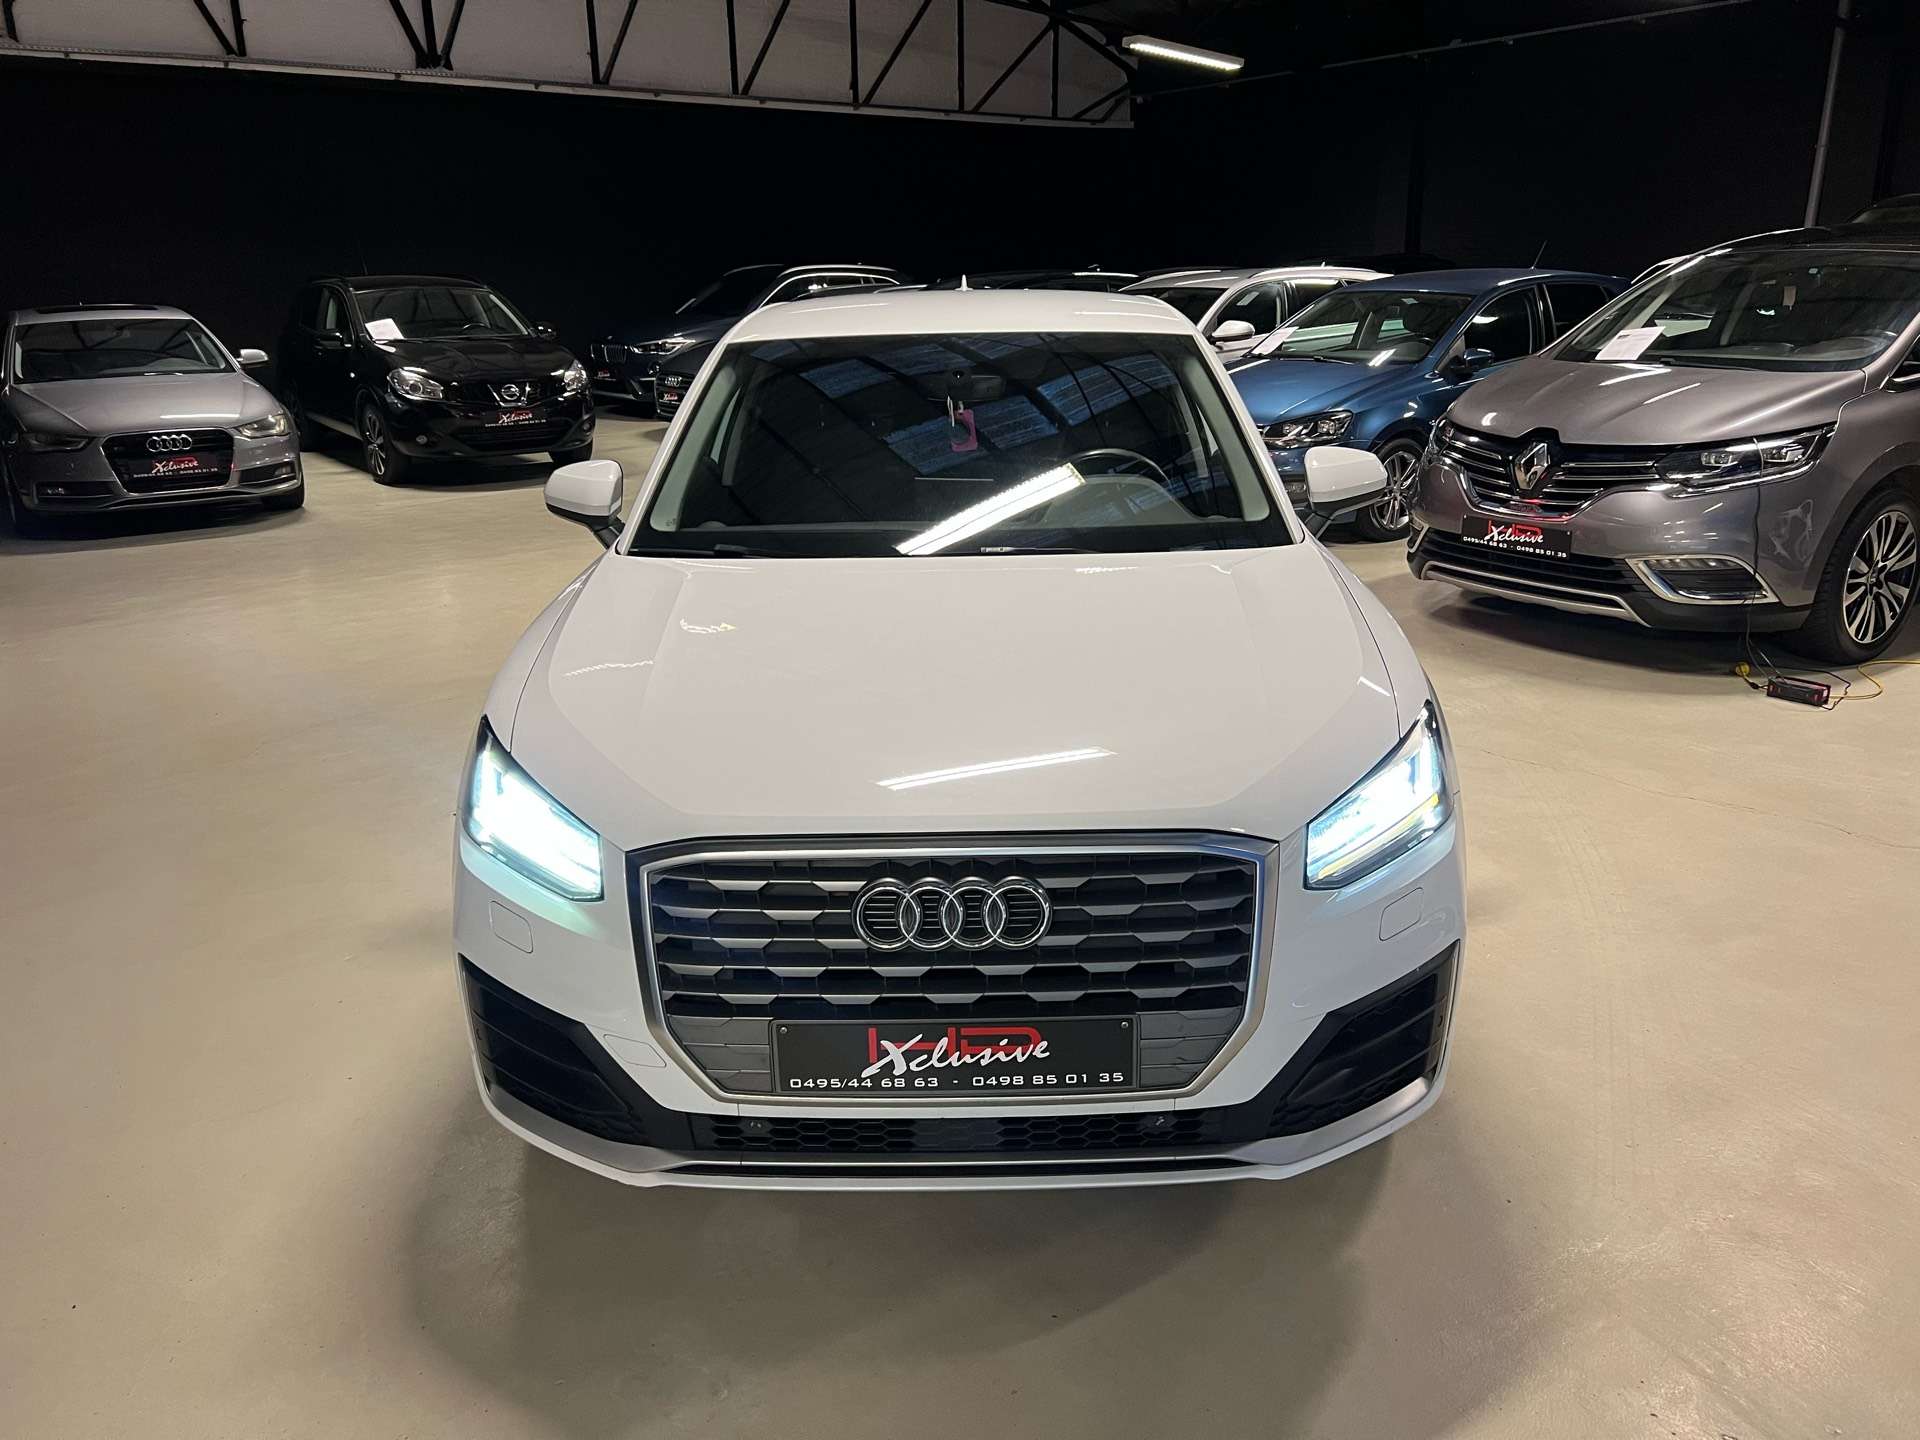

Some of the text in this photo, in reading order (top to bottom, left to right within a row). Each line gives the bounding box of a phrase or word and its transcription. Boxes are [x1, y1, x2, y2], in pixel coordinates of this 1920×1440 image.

[151, 461, 199, 474] Xclusive
[1484, 525, 1544, 543] Xclusive
[861, 1033, 1050, 1078] Xclusive
[789, 1078, 873, 1089] 0495/44
[881, 1078, 906, 1088] 68
[914, 1077, 939, 1088] 63
[972, 1075, 1025, 1086] 0498
[1032, 1074, 1058, 1085] 85
[1065, 1073, 1088, 1084] 01
[1099, 1072, 1124, 1083] 35
